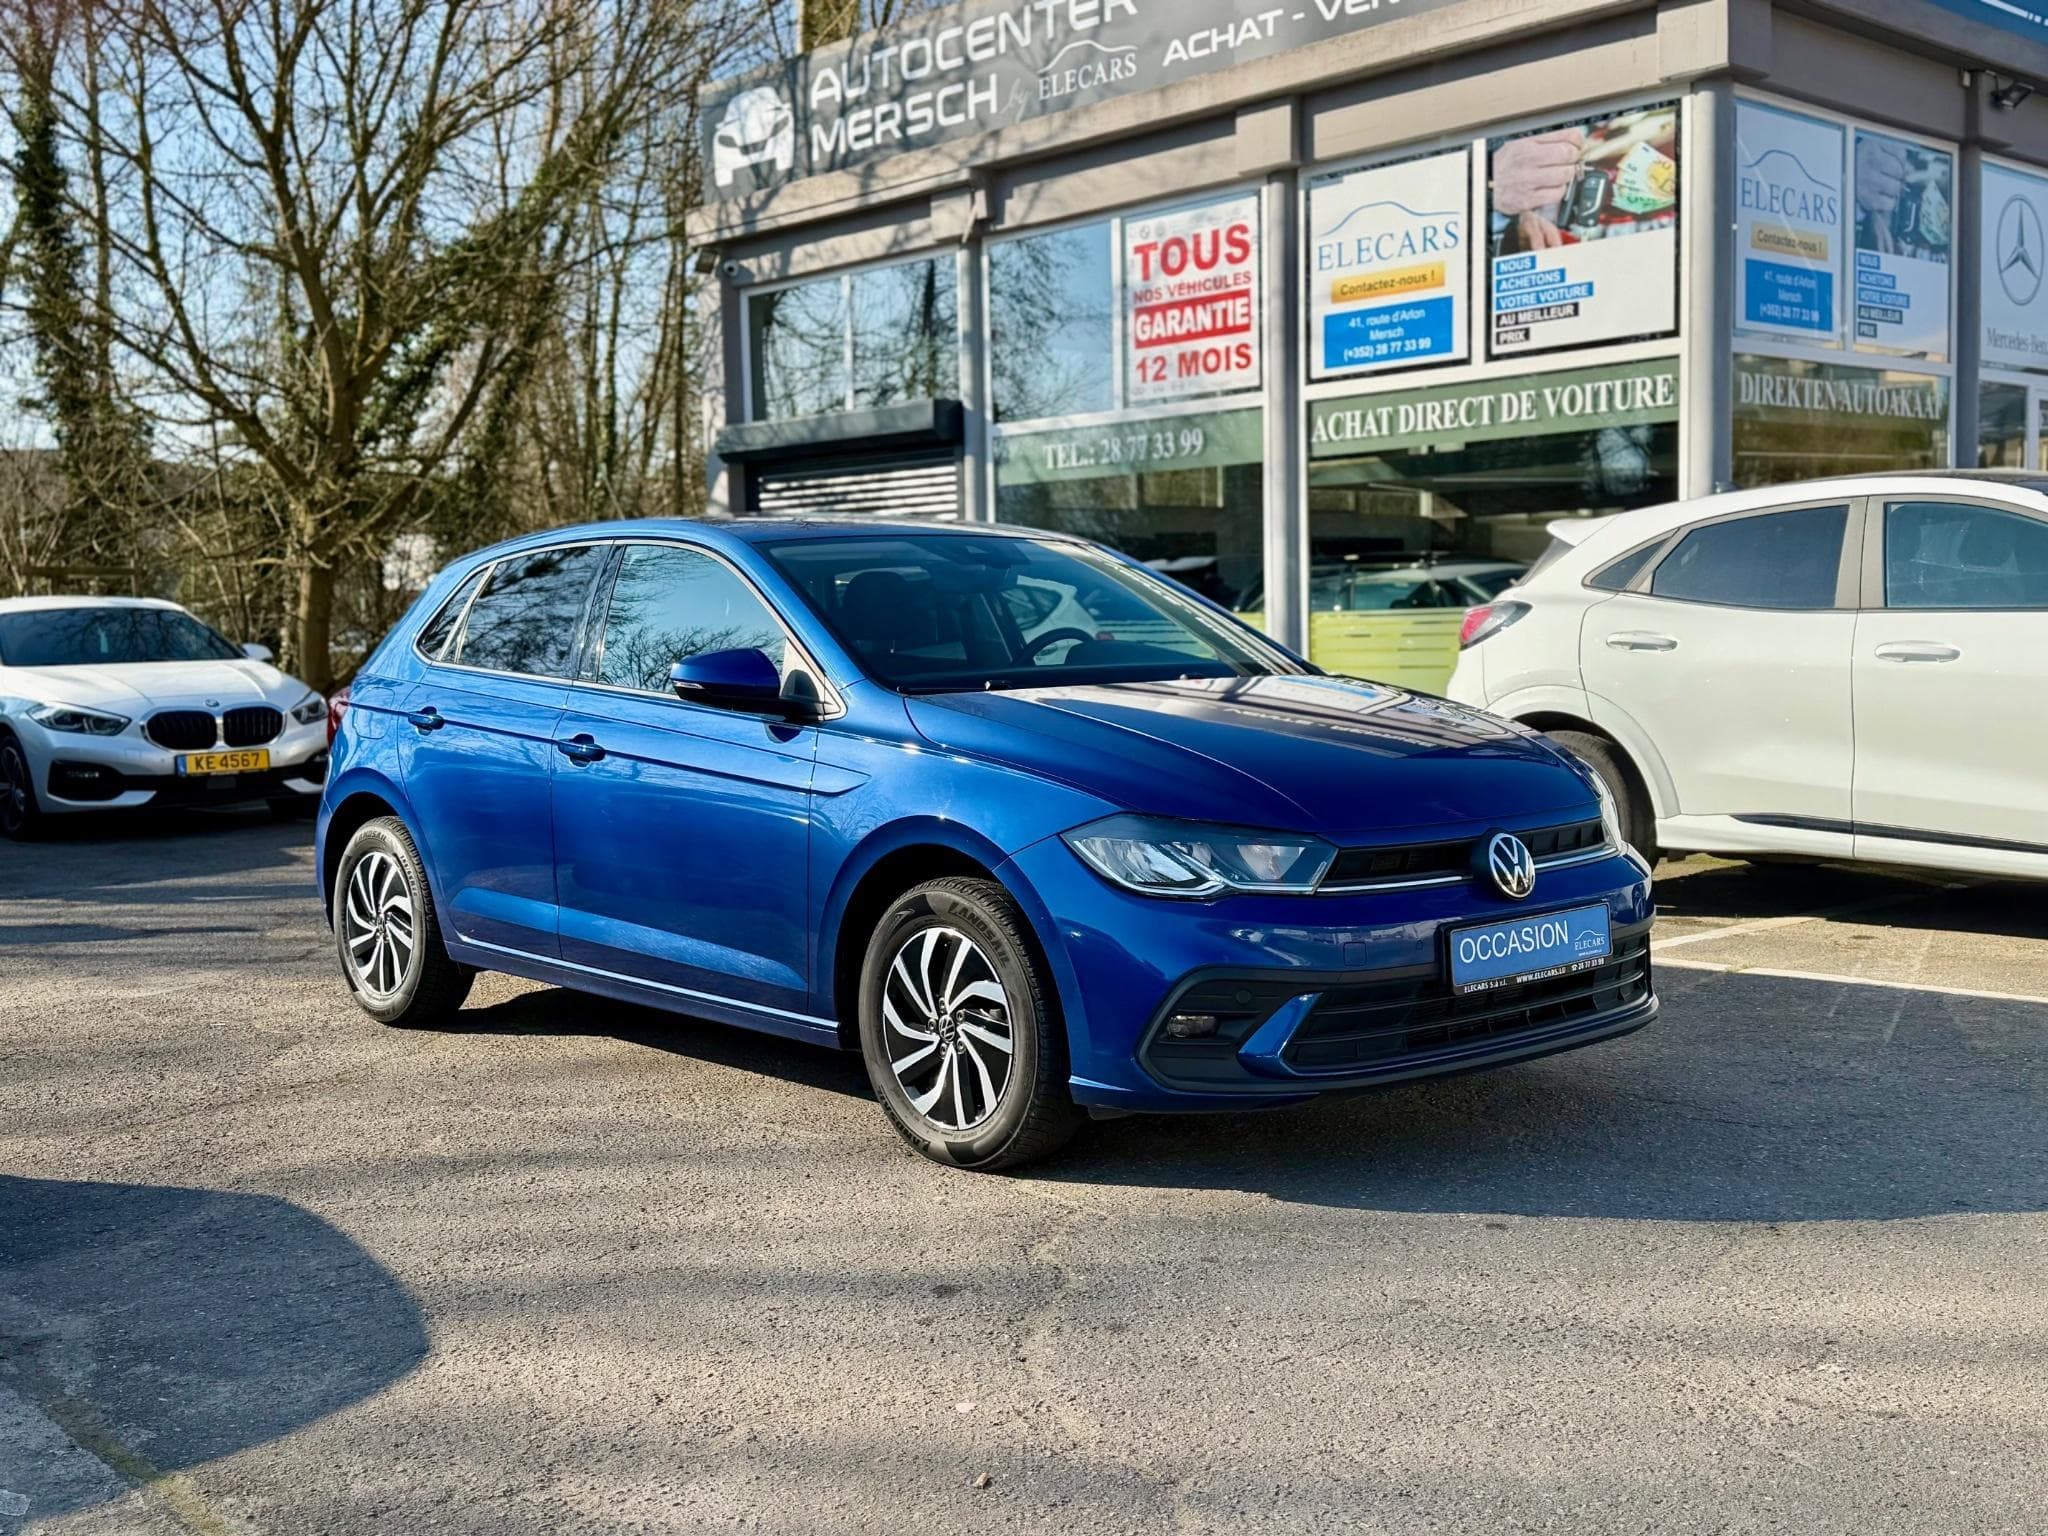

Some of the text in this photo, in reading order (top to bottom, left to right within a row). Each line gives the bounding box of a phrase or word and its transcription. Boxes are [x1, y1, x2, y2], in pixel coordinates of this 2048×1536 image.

[1162, 8, 1284, 67] ACHAT
[811, 73, 998, 162] MERSCH
[1038, 53, 1137, 101] ELECARS
[1740, 177, 1837, 226] ELECARS
[1133, 223, 1250, 282] TOUS
[1318, 221, 1460, 272] ELECARS
[1500, 258, 1532, 272] NOUS
[1340, 275, 1428, 296] Contactez-nous
[1500, 271, 1561, 290] ACHETONS
[1134, 287, 1162, 304] NOS
[1500, 285, 1588, 308] VOTRE VOITURE
[1136, 298, 1249, 341] GARANTIE
[1366, 313, 1391, 326] route
[1500, 305, 1575, 326] AU MEILLEUR
[1369, 327, 1405, 341] Mersch
[1500, 331, 1526, 344] PRIX
[1376, 343, 1388, 356] 28
[1390, 341, 1402, 354] 77
[1404, 339, 1417, 352] 33
[1136, 343, 1252, 383] 12 MOIS
[1741, 372, 1837, 411] DIREKTEN
[1311, 374, 1674, 443] ACHAT DIRECT DE VOITURE
[1100, 437, 1122, 464] 28
[1126, 434, 1148, 461] 77
[1152, 431, 1176, 459] 33
[1180, 427, 1204, 457] 99
[195, 752, 260, 770] KE 4567
[1459, 920, 1605, 964] OCCASION ELECARS
[1464, 982, 1489, 994] ELECARS
